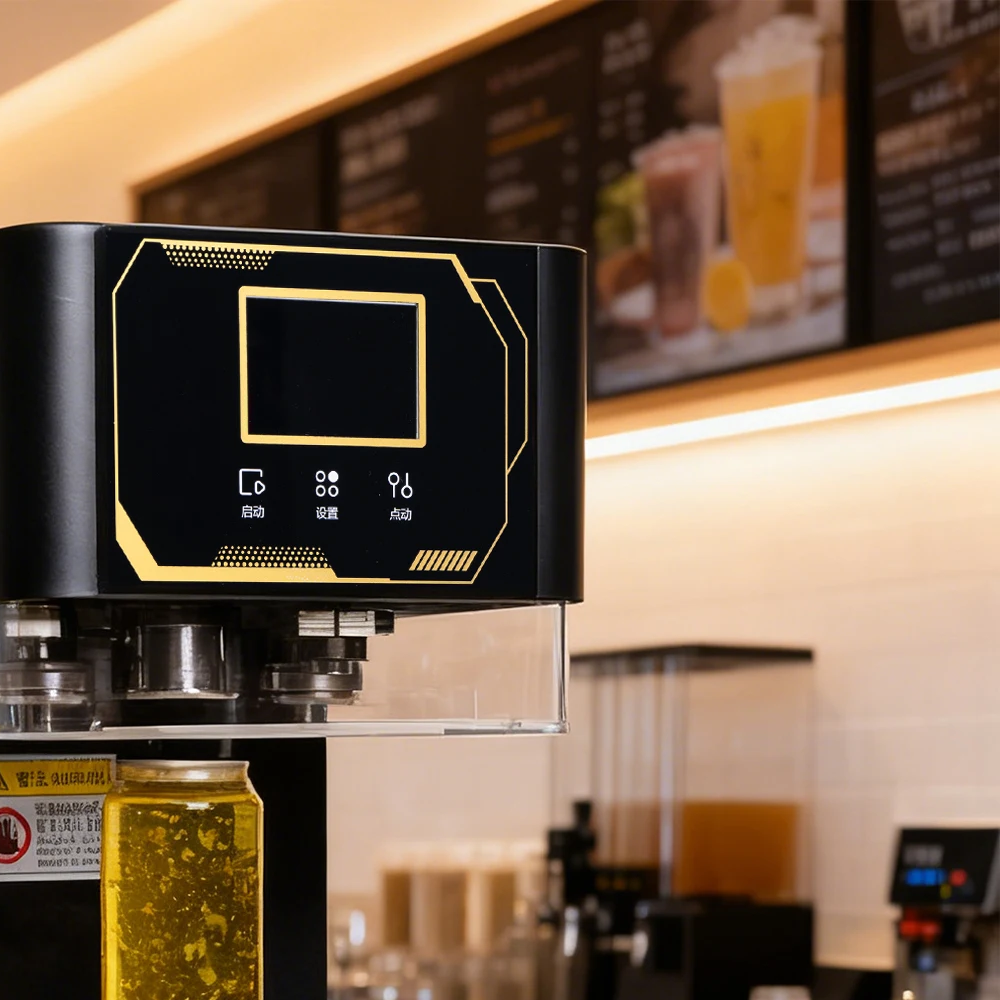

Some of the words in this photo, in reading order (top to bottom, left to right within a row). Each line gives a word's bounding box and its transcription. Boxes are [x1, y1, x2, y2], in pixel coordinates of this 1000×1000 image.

[241, 505, 264, 518] 启动
[316, 507, 338, 520] 设置
[390, 507, 412, 521] 点动
